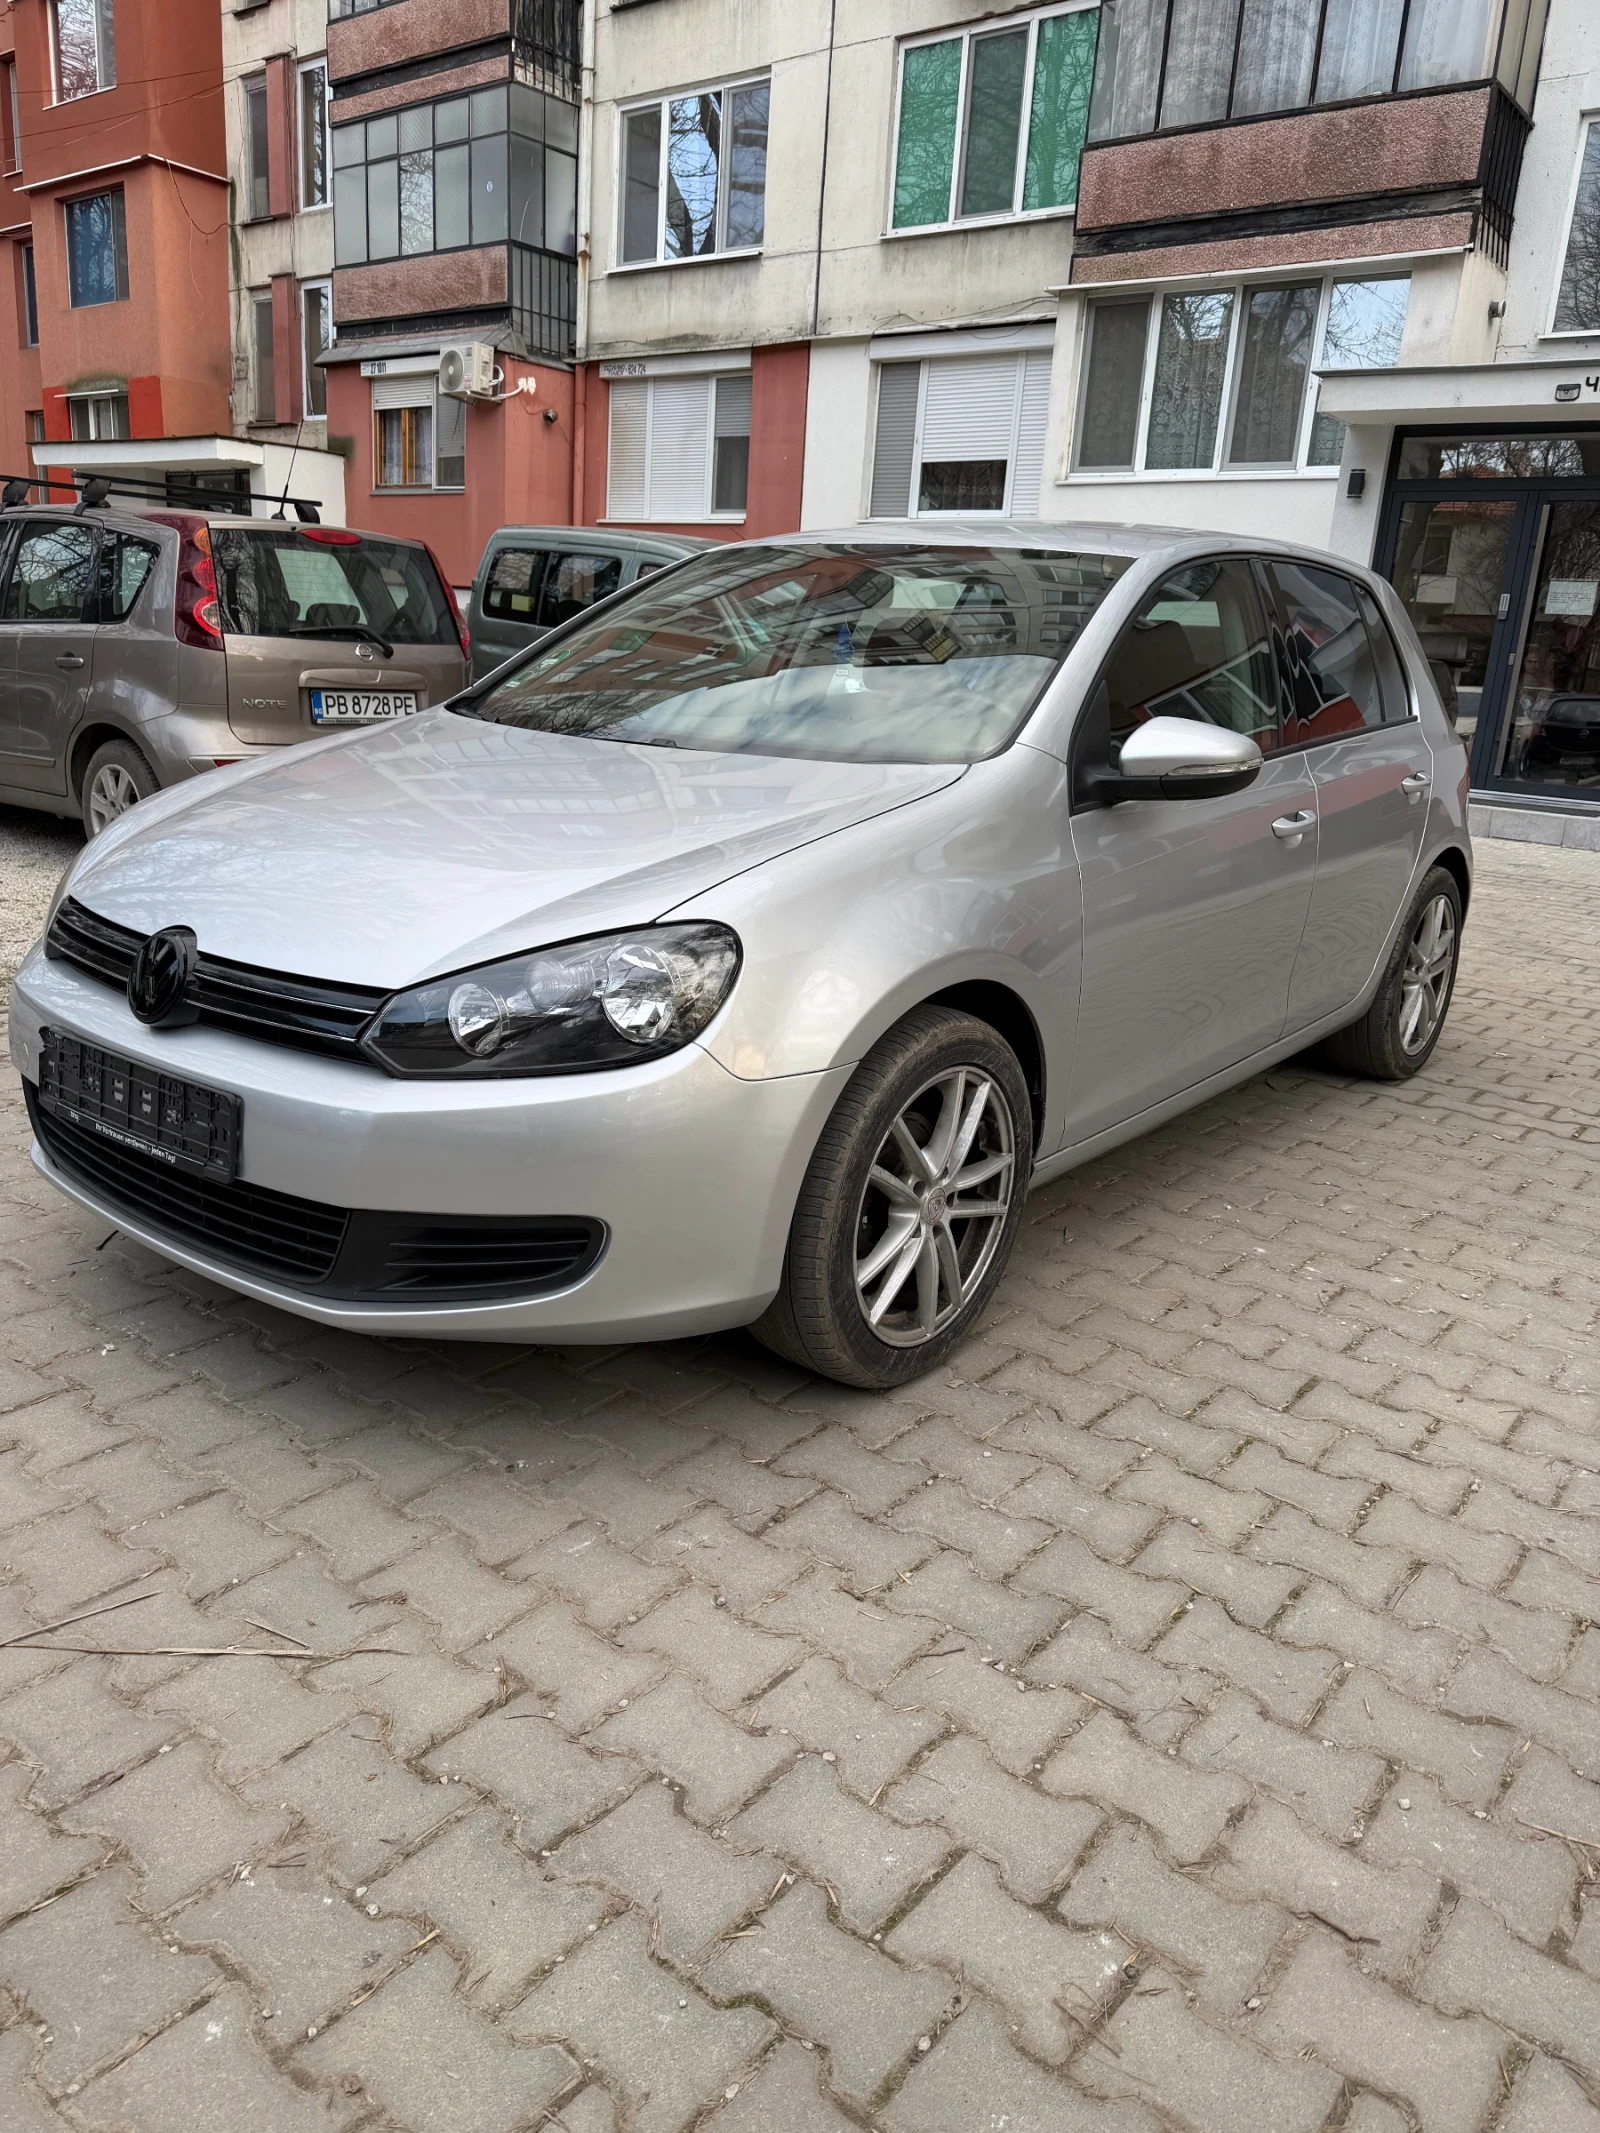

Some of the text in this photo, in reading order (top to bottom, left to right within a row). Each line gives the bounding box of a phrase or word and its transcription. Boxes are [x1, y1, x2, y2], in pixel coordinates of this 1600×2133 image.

[242, 698, 288, 709] NOTE
[325, 695, 414, 716] PB 8728 PE
[314, 707, 323, 716] BG
[102, 1125, 124, 1141] Vertrauen
